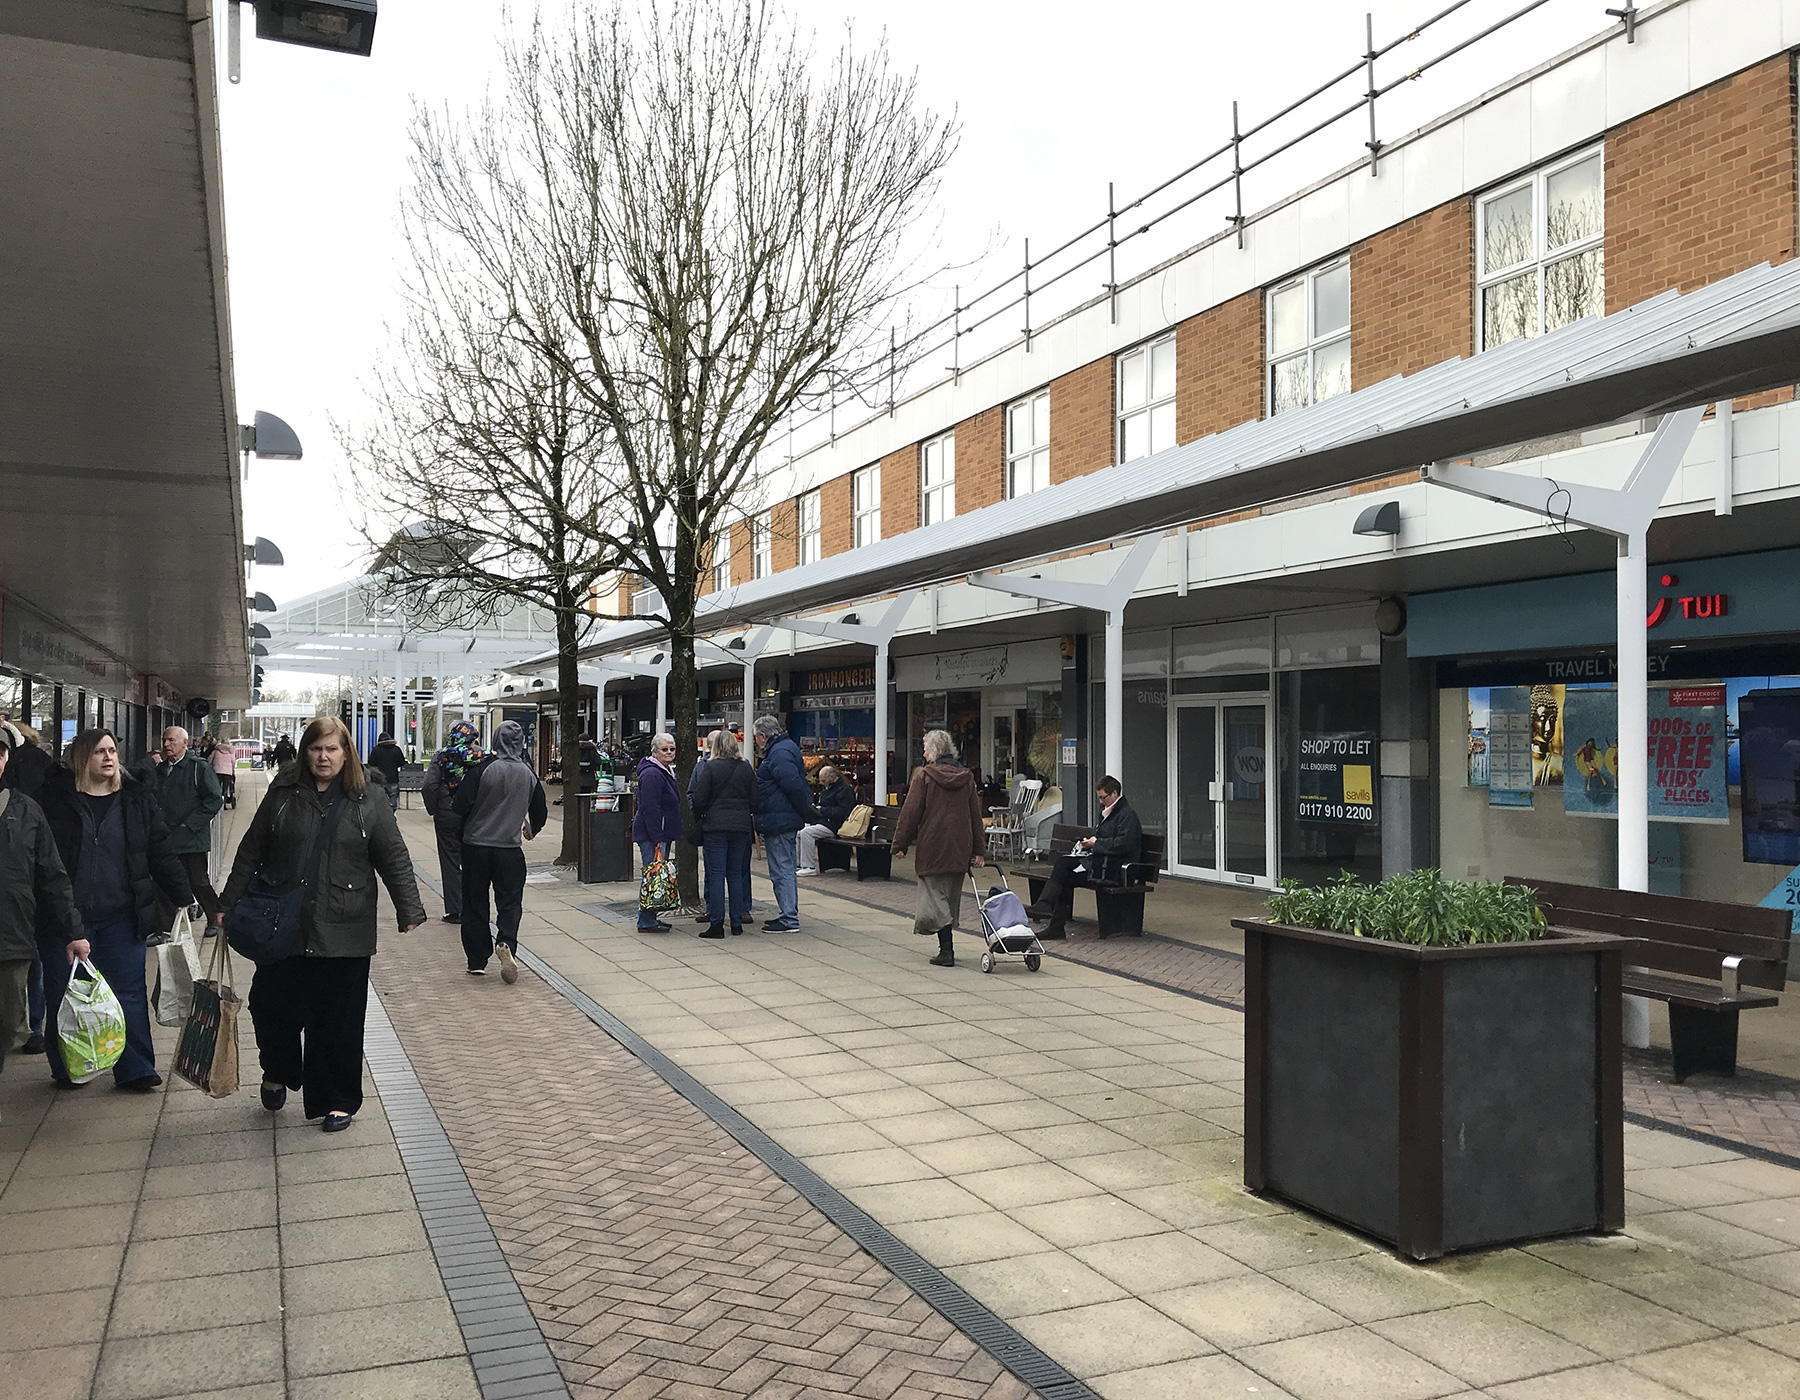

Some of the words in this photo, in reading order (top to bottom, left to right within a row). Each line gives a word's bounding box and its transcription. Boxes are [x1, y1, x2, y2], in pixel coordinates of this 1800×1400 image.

[1679, 593, 1725, 619] TUI
[1545, 659, 1604, 677] TRAVEL
[1608, 655, 1670, 675] MEY
[1696, 722, 1712, 736] OF
[1301, 739, 1330, 754] SHOP
[1332, 740, 1347, 755] TO
[1350, 740, 1371, 755] LET
[1310, 763, 1337, 772] ENQUIRIES
[1346, 790, 1370, 801] savills
[1299, 803, 1322, 816] 0117
[1324, 804, 1343, 818] 910
[1345, 805, 1373, 820] 2200
